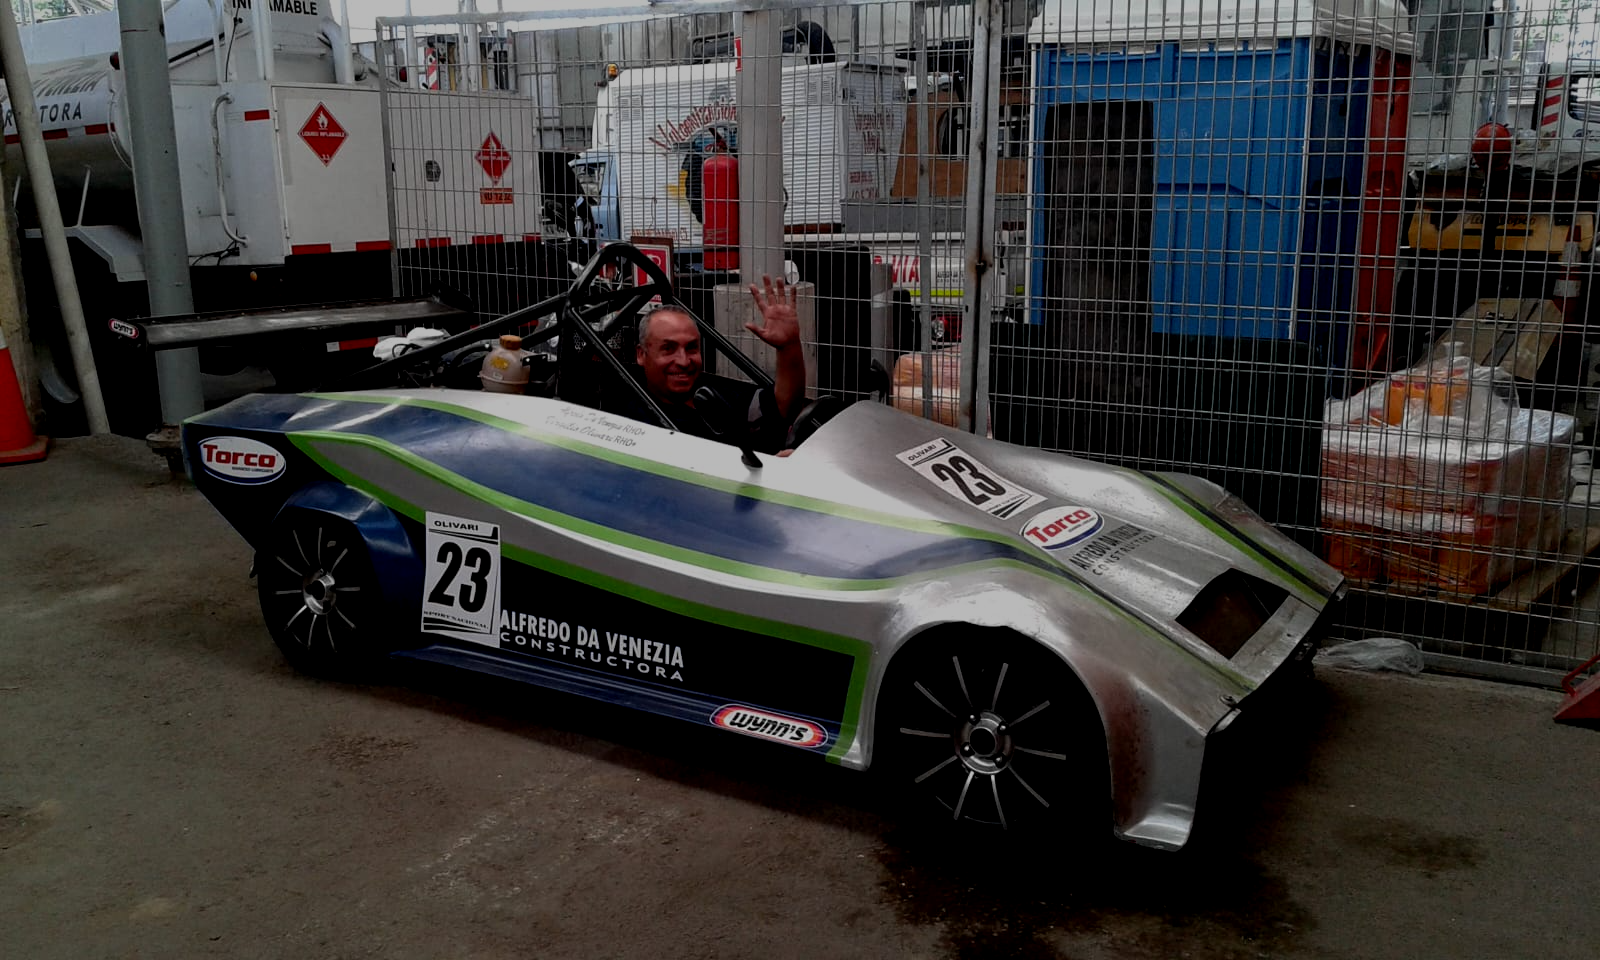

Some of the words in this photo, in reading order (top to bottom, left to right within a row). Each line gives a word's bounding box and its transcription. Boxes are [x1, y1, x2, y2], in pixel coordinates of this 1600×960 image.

[203, 444, 276, 468] Torco
[908, 444, 937, 462] OLIVARI
[931, 455, 1007, 506] 23
[434, 520, 479, 531] OLIVARI
[1025, 509, 1092, 543] Torco
[428, 541, 492, 613] 23
[500, 609, 571, 643] ALFREDO
[576, 624, 601, 650] DA
[605, 631, 685, 668] VENEZIA
[500, 632, 684, 682] CONSTRUCTORA
